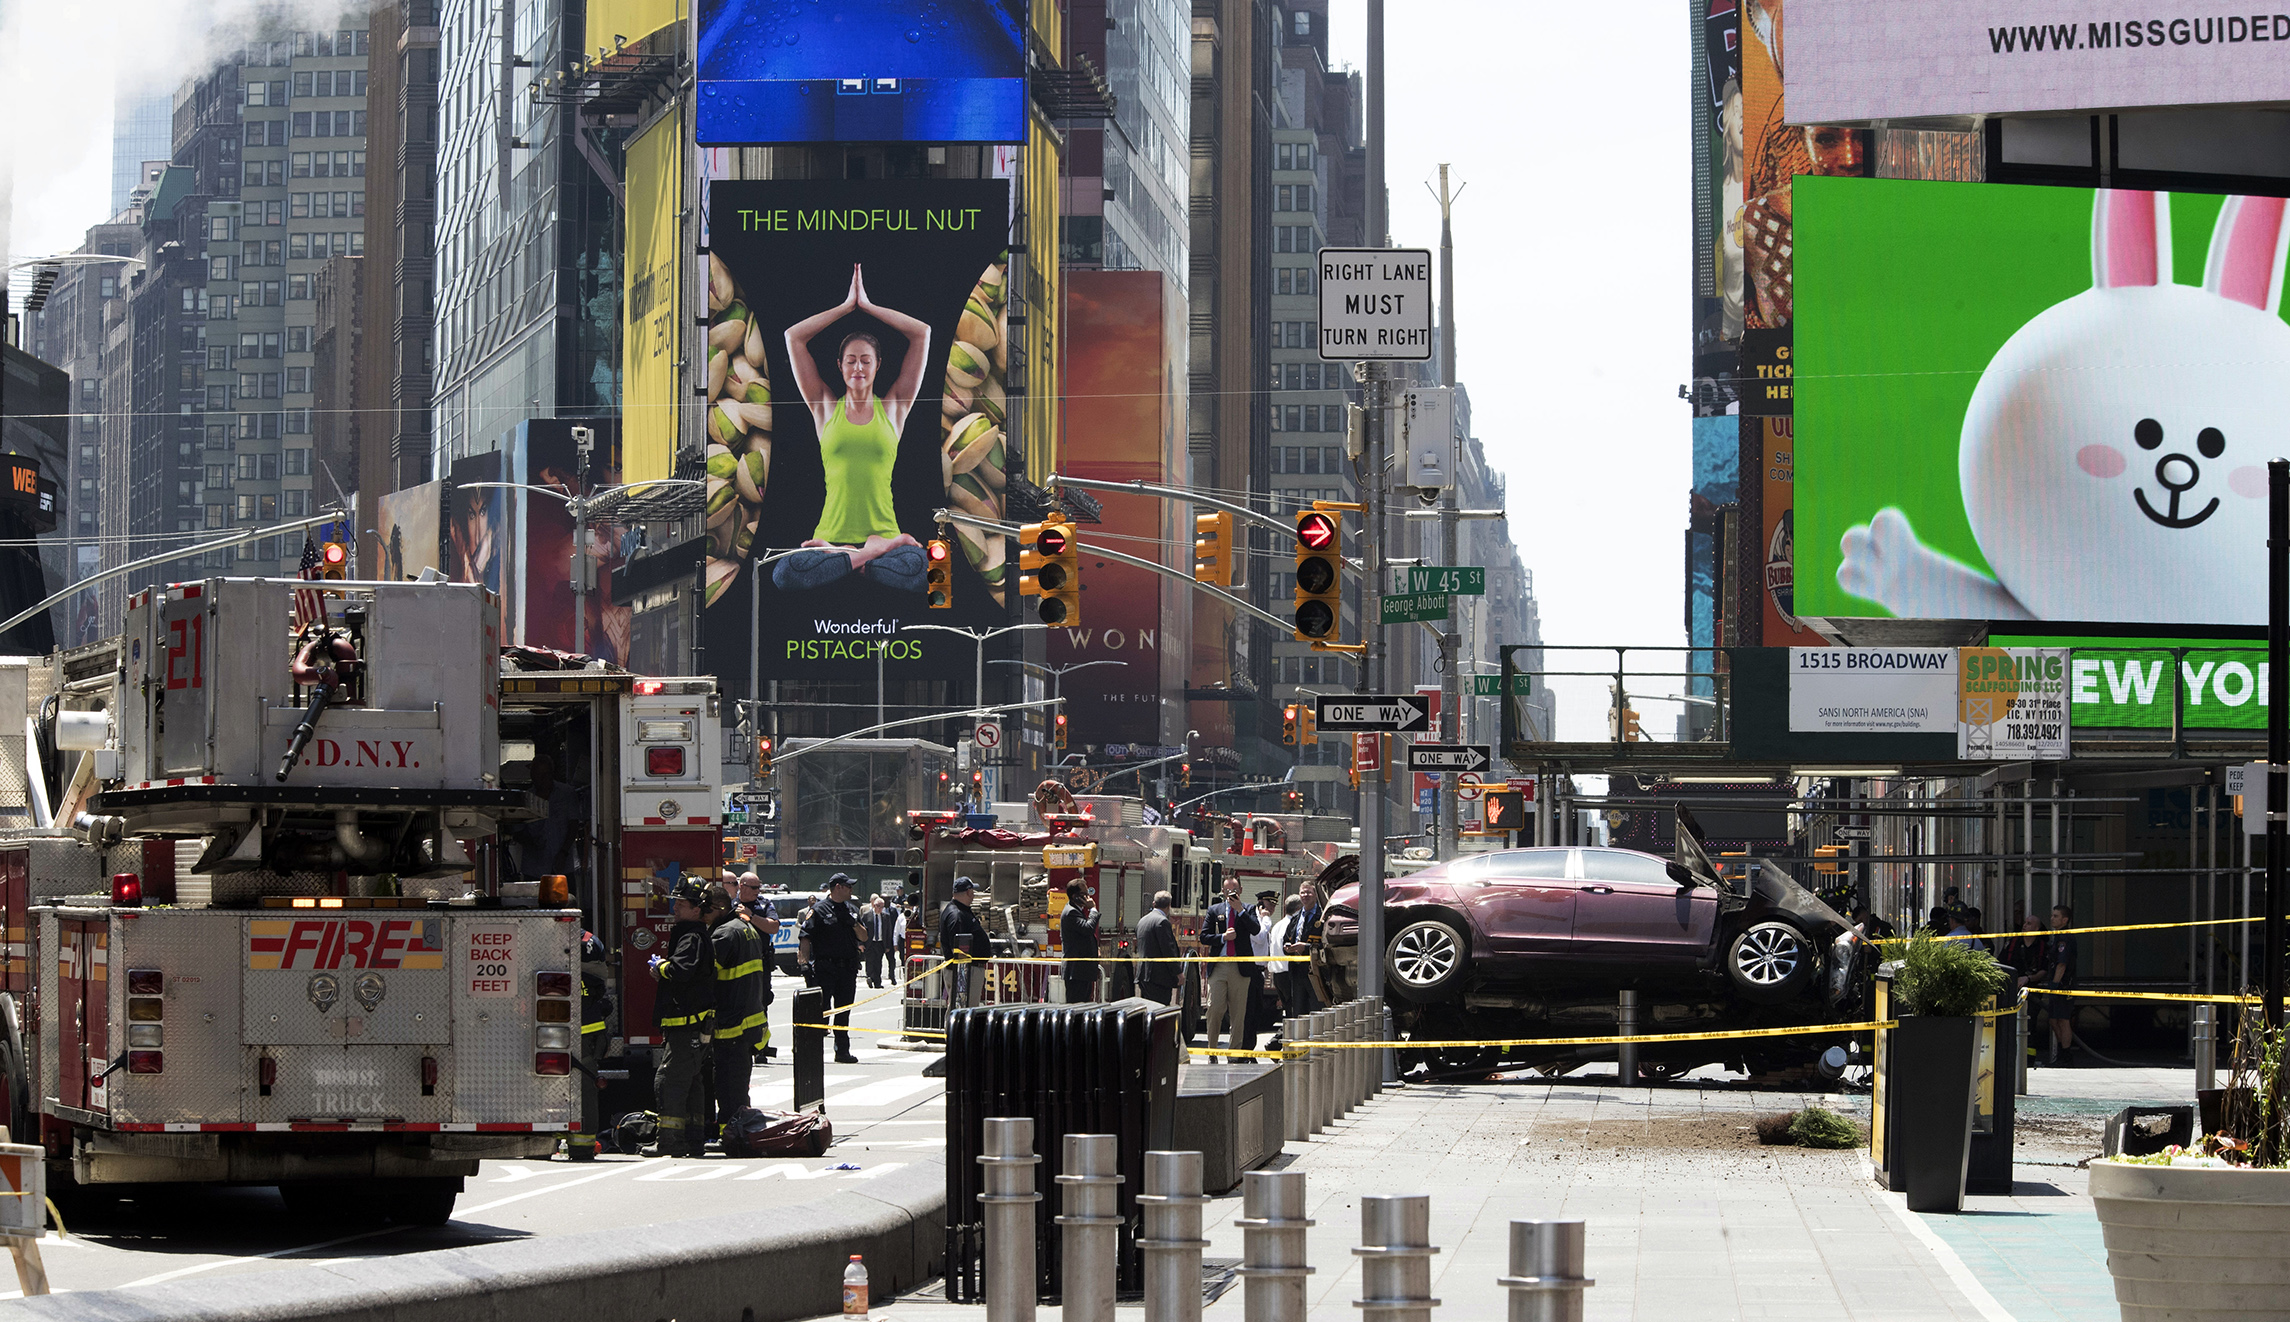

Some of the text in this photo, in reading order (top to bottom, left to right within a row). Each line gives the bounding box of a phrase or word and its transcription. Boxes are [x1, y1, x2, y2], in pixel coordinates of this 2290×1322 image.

[737, 209, 982, 231] THE MINDFUL NUT
[1324, 264, 1426, 280] RIGHT LANE
[1346, 294, 1404, 315] MUST
[1324, 328, 1427, 345] TURN RIGHT
[1413, 571, 1481, 592] W 45 St
[1383, 594, 1445, 615] George Abbott
[1409, 612, 1419, 621] Way
[814, 618, 899, 634] Wonderful
[167, 613, 202, 690] 21
[786, 640, 922, 659] PISTACHIOS
[1800, 653, 1948, 669] 1515 BROADWAY
[1966, 655, 2063, 681] SPRING
[1478, 680, 1490, 693] W
[1519, 678, 1528, 688] St
[1966, 681, 2062, 693] SCAFFOLDING LLC
[1103, 694, 1124, 702] THE
[2006, 699, 2027, 708] 49-30
[2042, 699, 2061, 708] Place
[1332, 707, 1412, 721] ONE WAY
[1819, 708, 1928, 719] SANSI NORTH AMERICA (SNA)
[2006, 710, 2062, 720] LIC, NY 11101
[2006, 724, 2062, 740] 718.392.4921
[1419, 753, 1478, 763] ONE WAY
[2228, 783, 2244, 792] KEEP
[280, 920, 414, 969] FIRE
[471, 933, 512, 945] KEEP
[470, 948, 513, 961] BACK
[476, 964, 507, 976] 200
[472, 980, 511, 991] FEET
[311, 1092, 386, 1113] TRUCK
